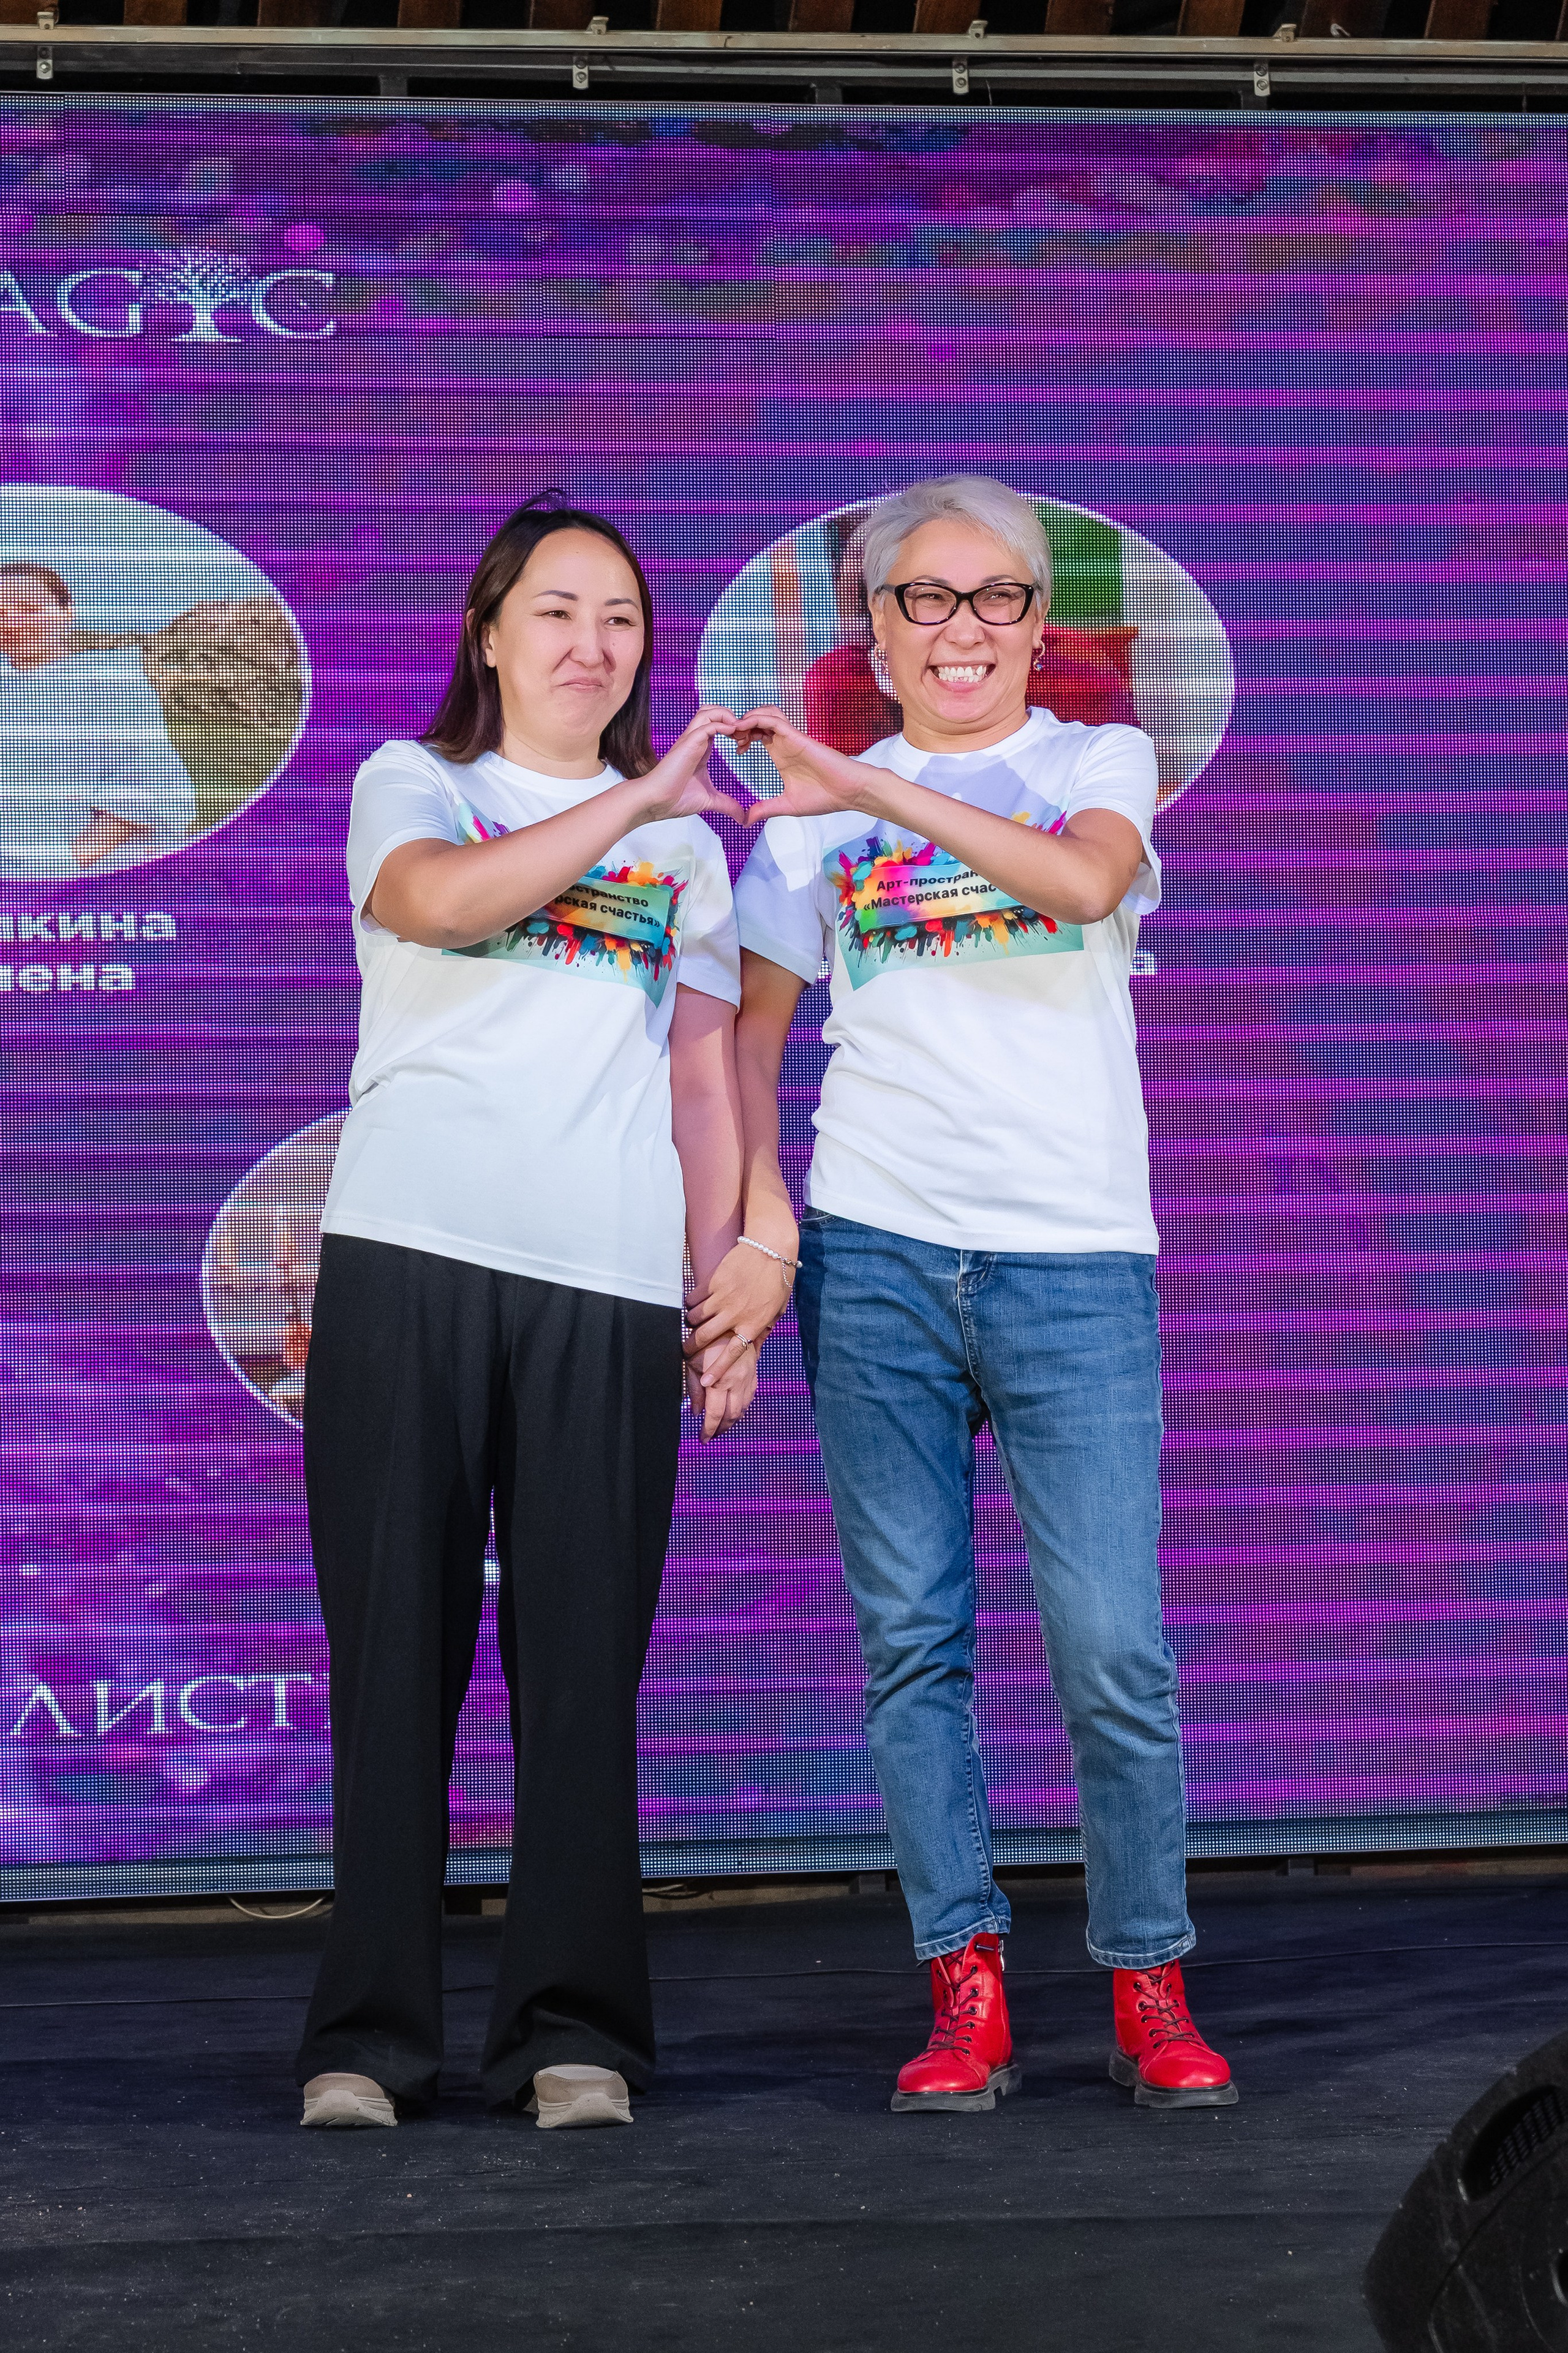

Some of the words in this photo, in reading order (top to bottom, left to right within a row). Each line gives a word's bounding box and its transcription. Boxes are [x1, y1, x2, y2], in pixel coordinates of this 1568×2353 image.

[864, 888, 959, 911] «Мастерская
[600, 904, 660, 928] счастья»
[9, 1671, 331, 1736] ЛИСТ
